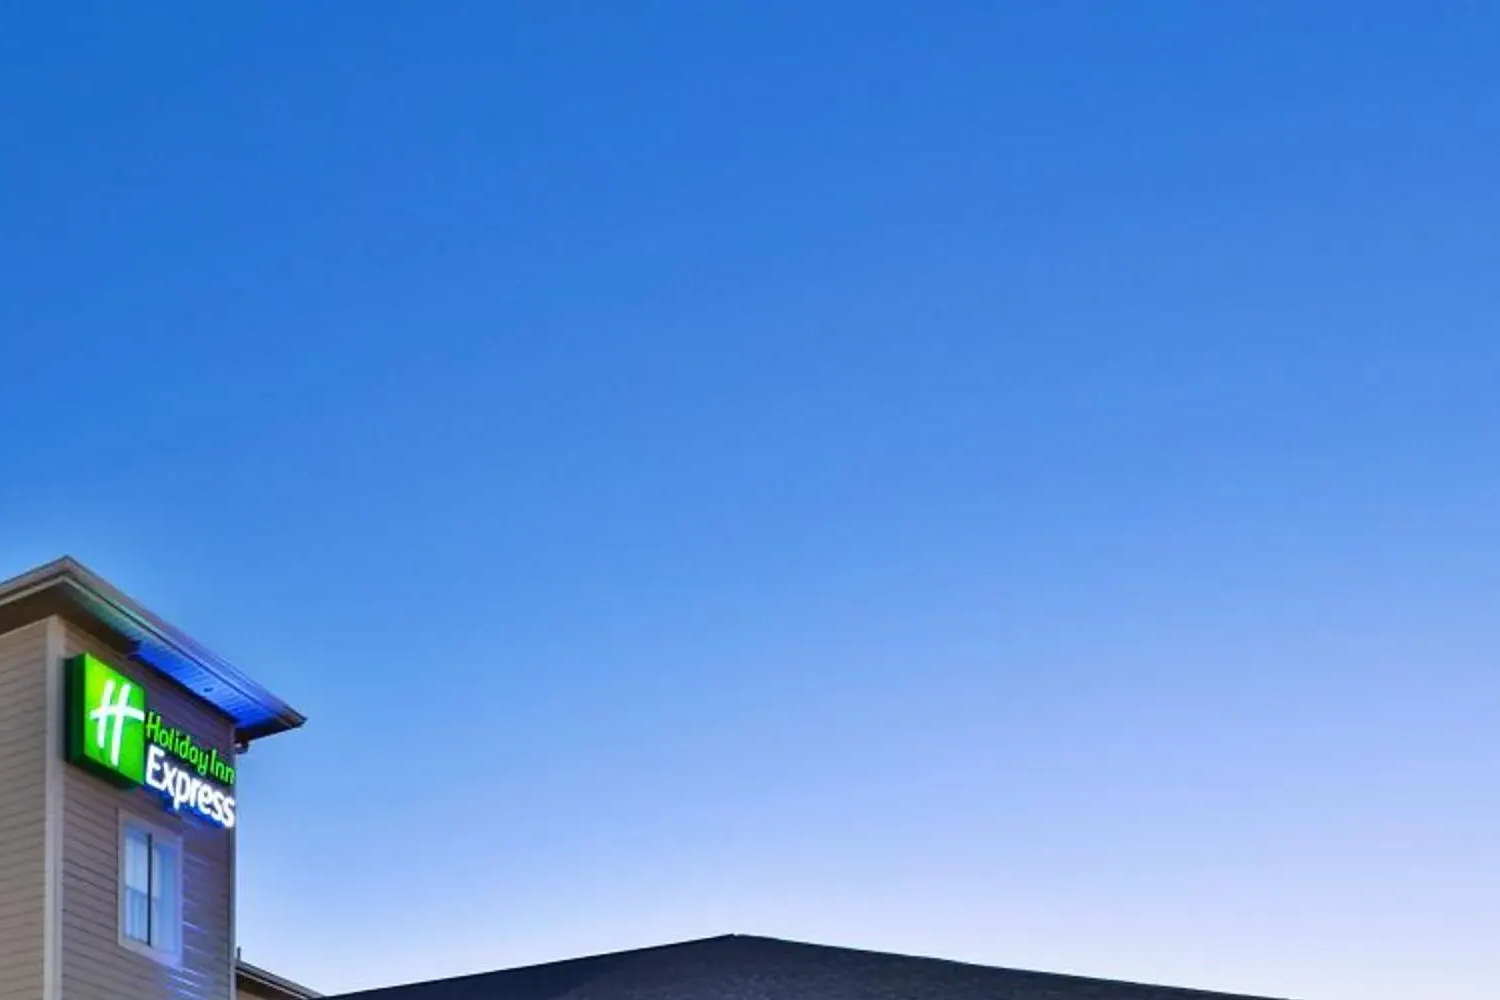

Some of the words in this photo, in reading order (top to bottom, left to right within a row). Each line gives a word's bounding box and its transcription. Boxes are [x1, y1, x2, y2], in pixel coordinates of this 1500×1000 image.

[145, 743, 236, 828] Express
[146, 711, 209, 776] Holiday
[210, 748, 235, 784] Inn
